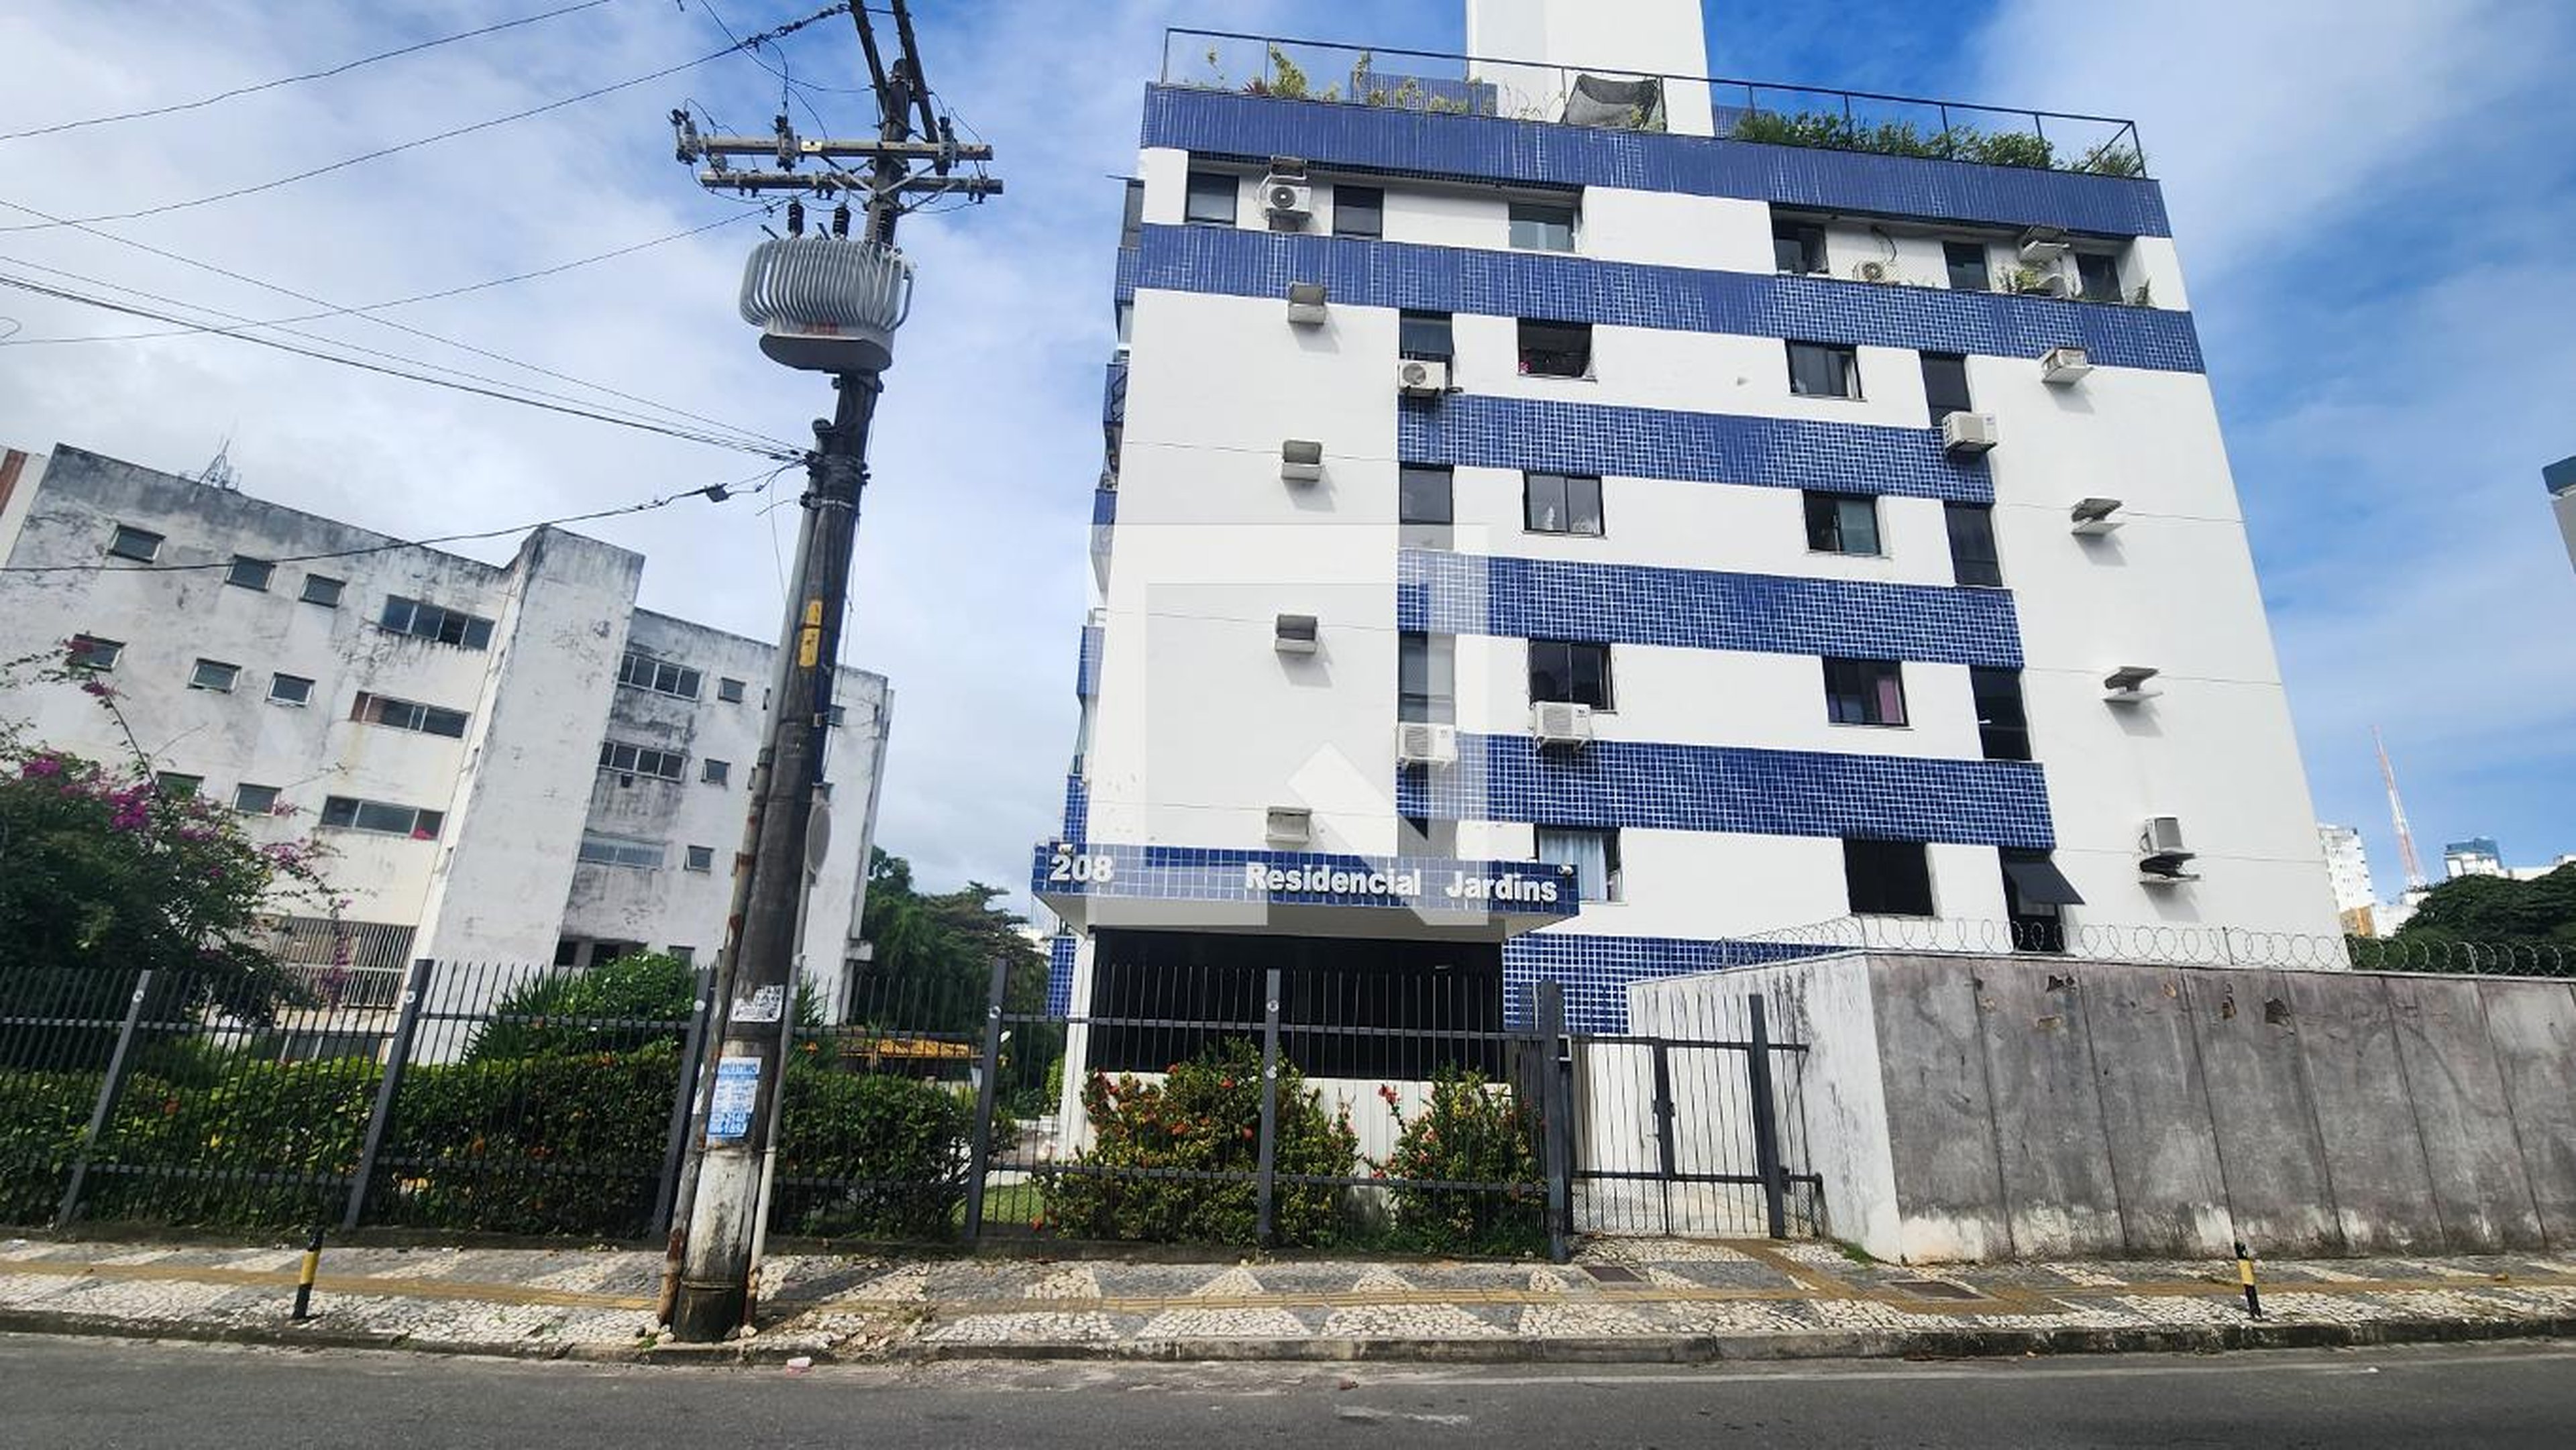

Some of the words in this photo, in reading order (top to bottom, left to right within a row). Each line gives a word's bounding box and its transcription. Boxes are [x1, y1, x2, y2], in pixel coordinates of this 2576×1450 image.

[1049, 853, 1114, 884] 208
[1246, 862, 1422, 896] Residencial
[1445, 871, 1558, 902] Jardins
